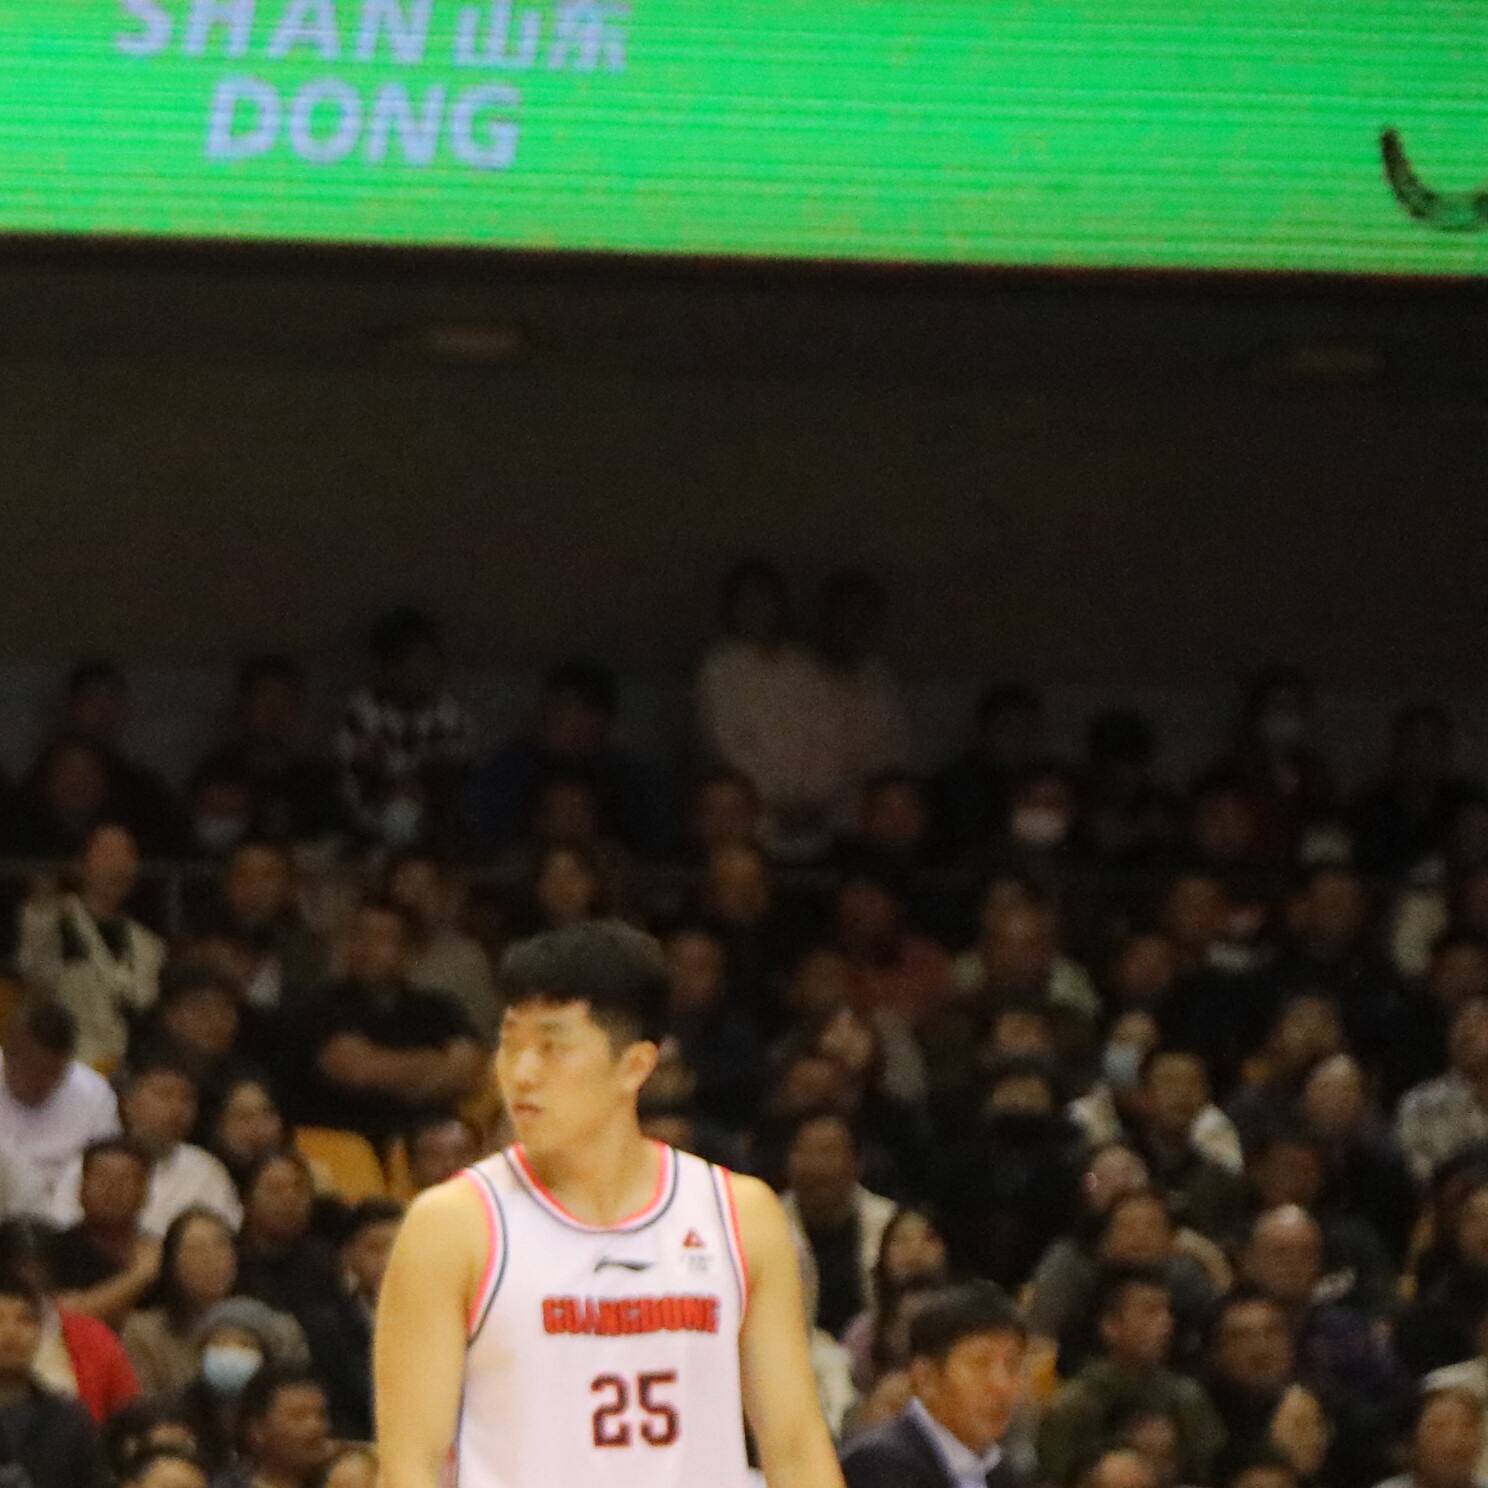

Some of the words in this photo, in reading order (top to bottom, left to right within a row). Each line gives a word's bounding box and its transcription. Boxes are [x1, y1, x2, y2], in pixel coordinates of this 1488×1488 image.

[116, 0, 432, 64] SHAN
[204, 76, 522, 170] DONG
[591, 1370, 681, 1449] 25
